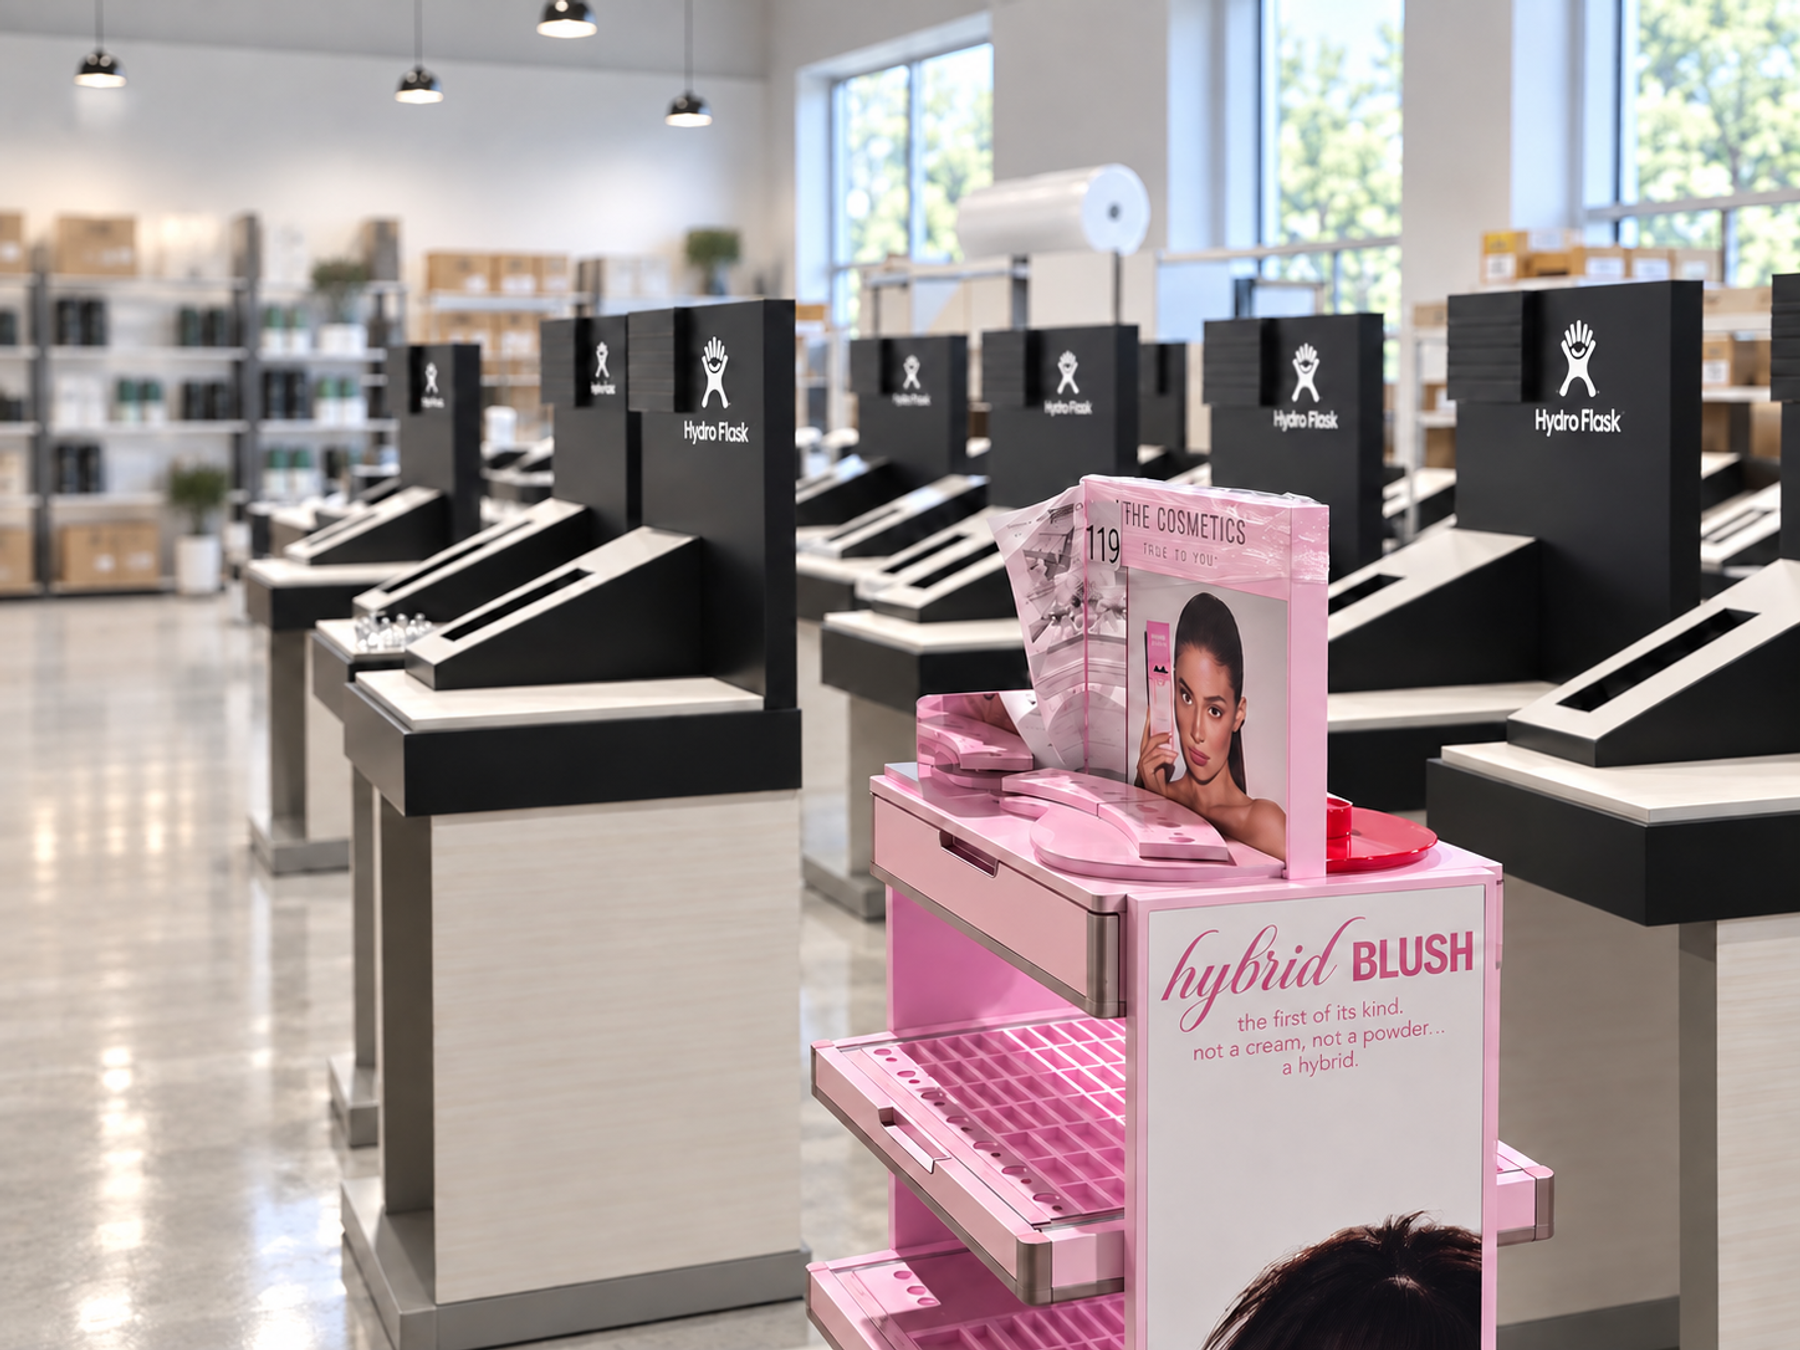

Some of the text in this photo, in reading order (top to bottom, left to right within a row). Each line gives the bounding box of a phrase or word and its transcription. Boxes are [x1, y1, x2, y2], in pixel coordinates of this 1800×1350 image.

[684, 420, 749, 445] Hydro Flask
[1273, 409, 1339, 432] Hydro Flask
[1535, 408, 1621, 437] Hydro Flask
[1123, 501, 1246, 545] THE COSMETICS
[1086, 524, 1120, 564] 119
[1175, 549, 1187, 562] TO
[1161, 916, 1474, 1033] hybrid BLUSH
[1237, 997, 1404, 1031] the first of its kind.
[1193, 1044, 1223, 1060] not
[1229, 1043, 1240, 1056] a
[1245, 1035, 1306, 1055] cream,
[1312, 1029, 1342, 1048] not
[1347, 1031, 1357, 1044] a
[1282, 1050, 1359, 1077] a hybrid.
